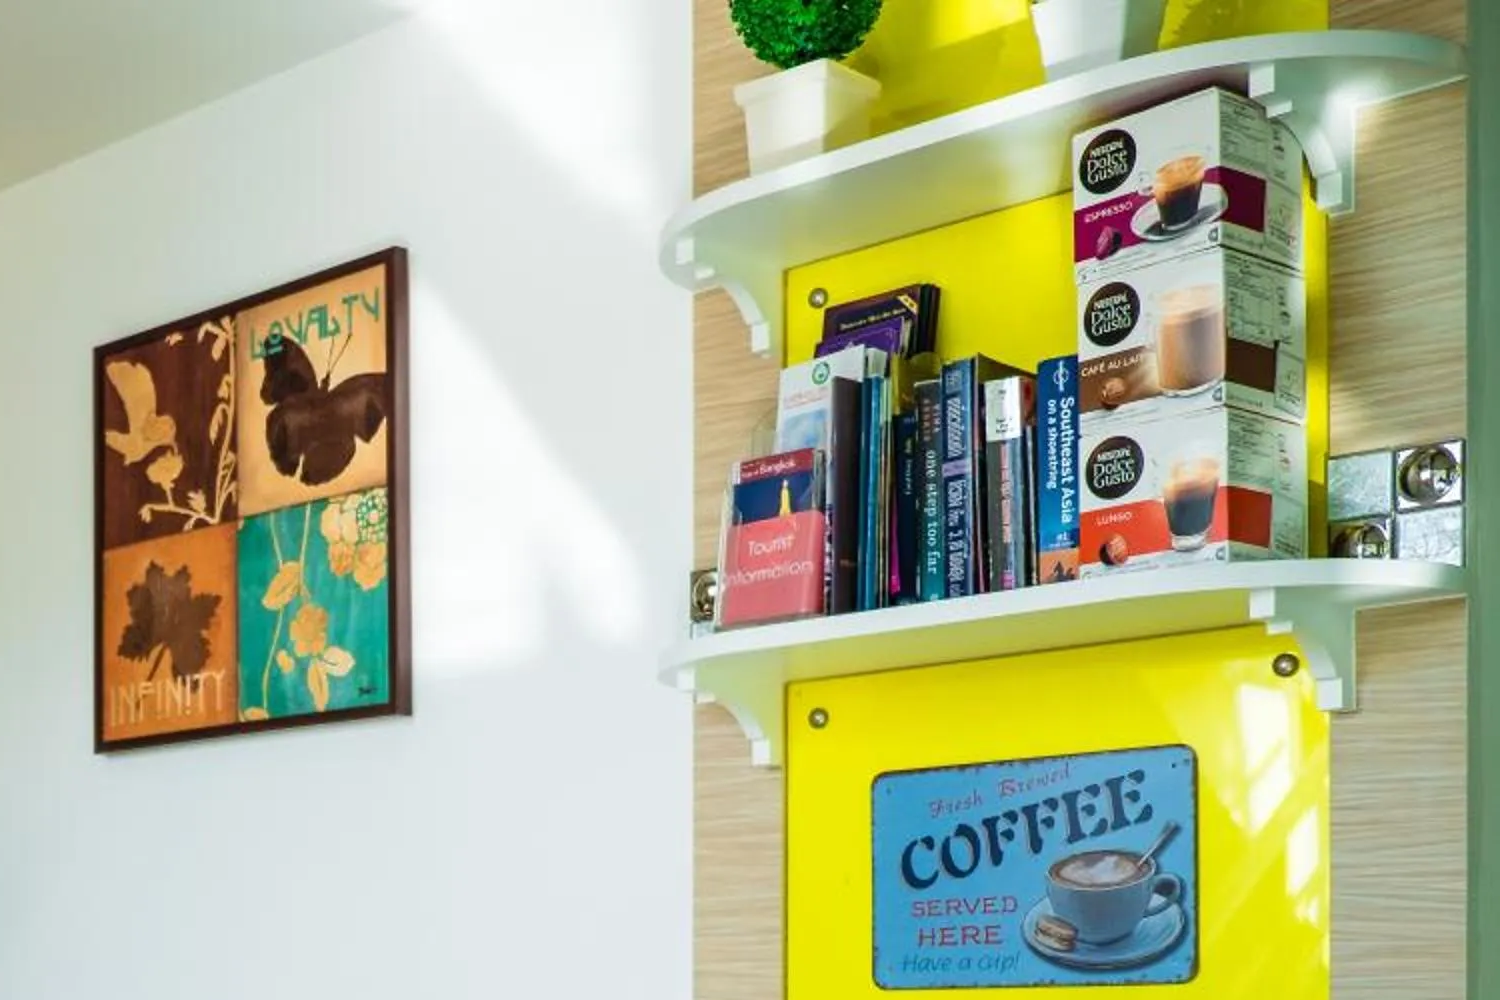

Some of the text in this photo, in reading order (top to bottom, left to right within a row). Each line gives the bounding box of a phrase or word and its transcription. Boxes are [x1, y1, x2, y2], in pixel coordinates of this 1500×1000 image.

[1084, 200, 1133, 223] ESPRESSO
[250, 285, 379, 361] LOYALTY
[1108, 359, 1121, 370] AU
[1045, 399, 1058, 490] on a shoestring
[1060, 396, 1075, 485] Southeast
[926, 449, 936, 477] one
[1093, 459, 1135, 478] Dolce
[1093, 471, 1135, 489] Gusto
[924, 483, 938, 517] step
[1061, 487, 1075, 524] Asia
[927, 520, 937, 547] too
[723, 560, 814, 587] nformation
[927, 551, 940, 574] far
[110, 668, 226, 728] INFINITY
[930, 761, 1071, 818] Fresh Brewed
[901, 769, 1154, 890] COFFEE
[911, 895, 1018, 918] SERVED
[918, 924, 1004, 947] HERE
[902, 953, 952, 973] Have
[959, 956, 972, 971] a
